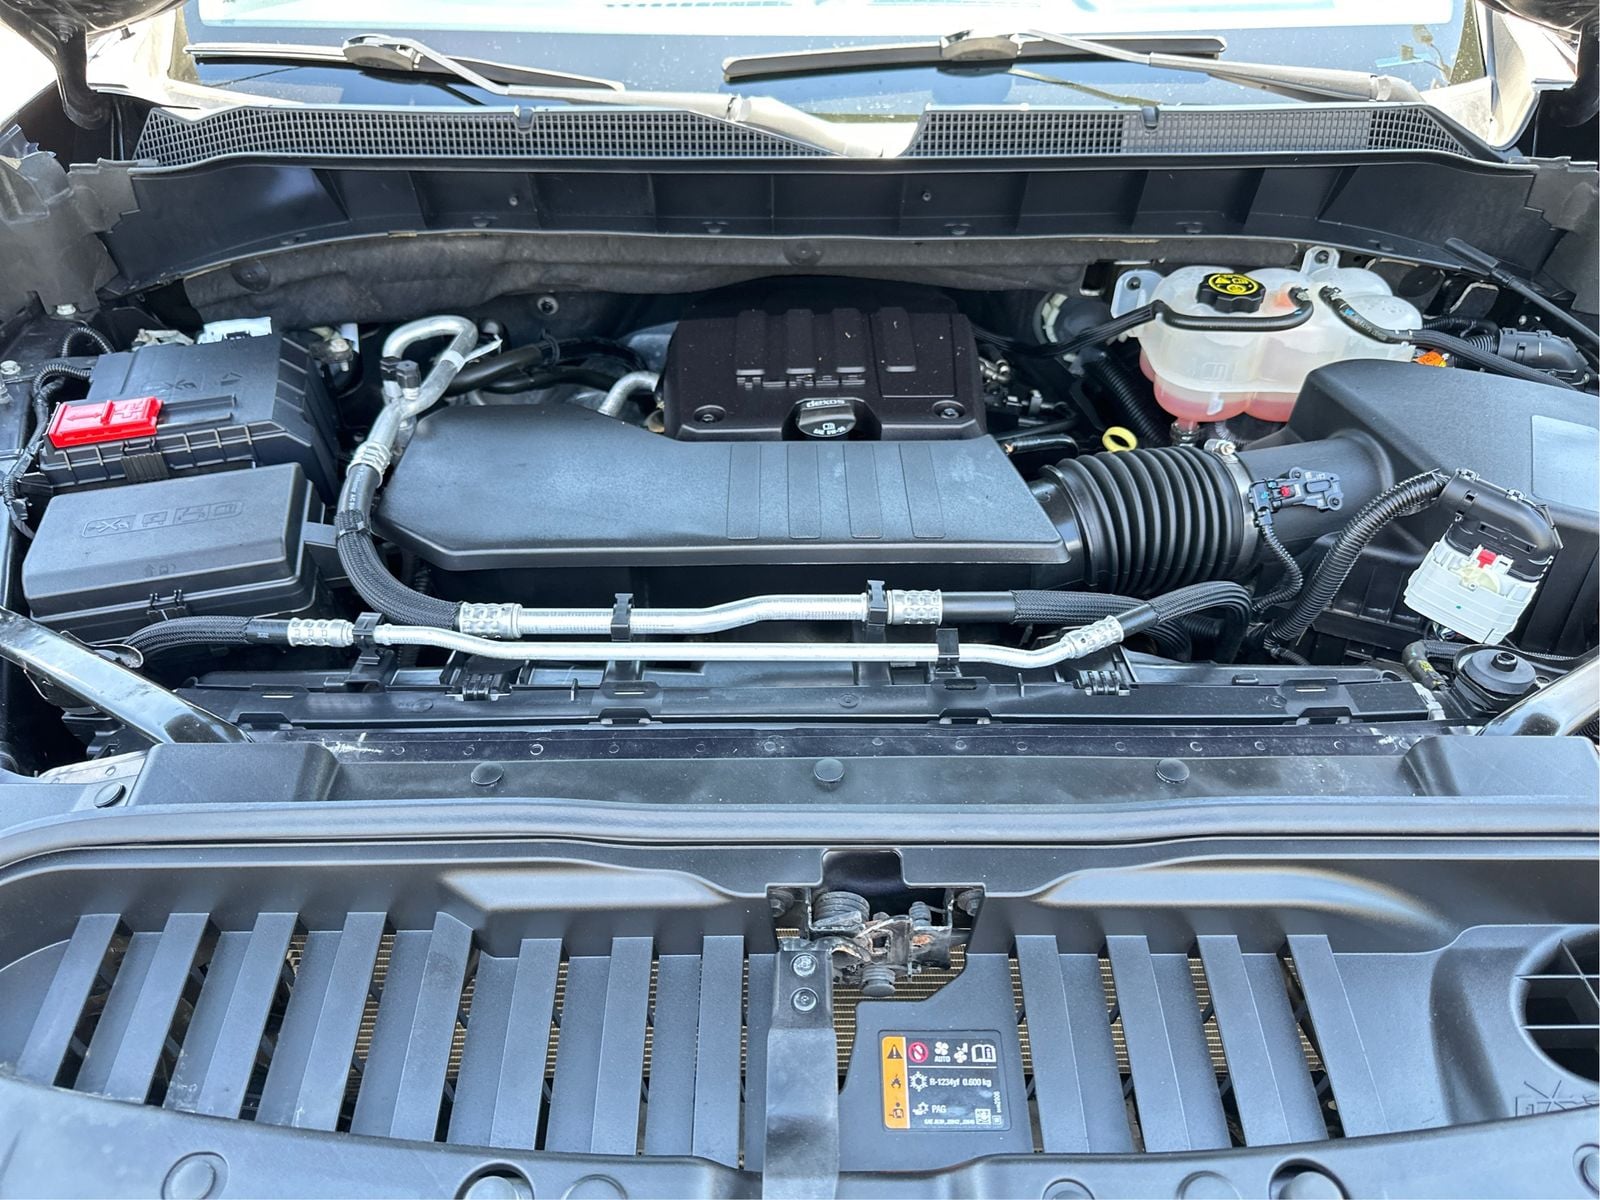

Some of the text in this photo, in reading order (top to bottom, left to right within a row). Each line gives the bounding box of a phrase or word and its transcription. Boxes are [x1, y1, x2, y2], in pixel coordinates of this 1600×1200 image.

[806, 400, 845, 408] dexos
[982, 1078, 991, 1087] kg
[931, 1105, 947, 1113] PAG
